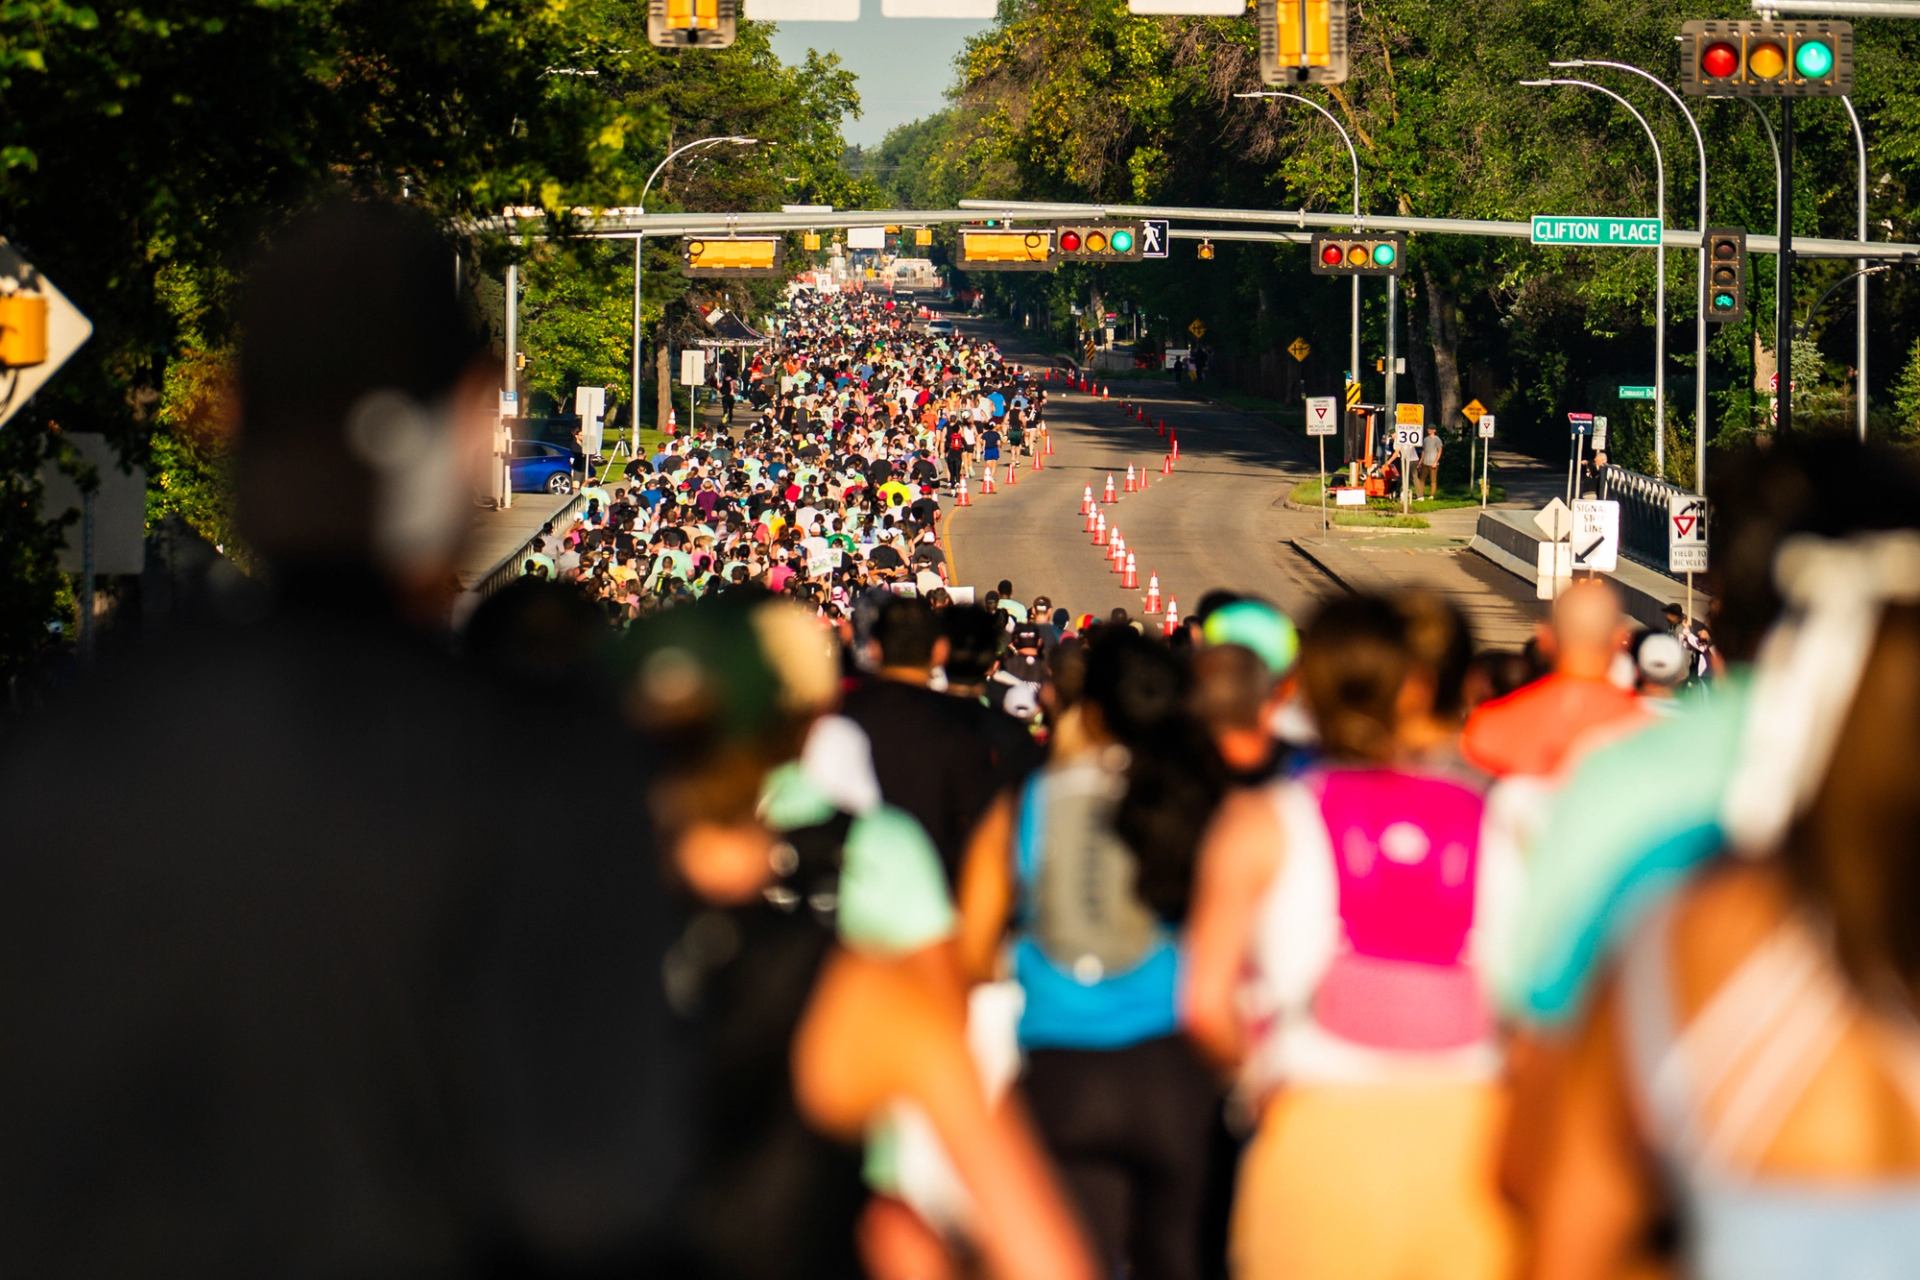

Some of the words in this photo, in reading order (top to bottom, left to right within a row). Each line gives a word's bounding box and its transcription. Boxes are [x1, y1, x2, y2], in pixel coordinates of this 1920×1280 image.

[1535, 221, 1599, 239] CLIFTON
[1609, 223, 1658, 240] PLACE
[1399, 431, 1420, 444] 30
[1576, 503, 1607, 513] SIGNA
[1584, 513, 1606, 523] ST
[1584, 523, 1603, 533] LINE
[1674, 550, 1694, 558] YIELD
[1697, 550, 1707, 558] TO
[1673, 559, 1707, 567] BICYCLES
